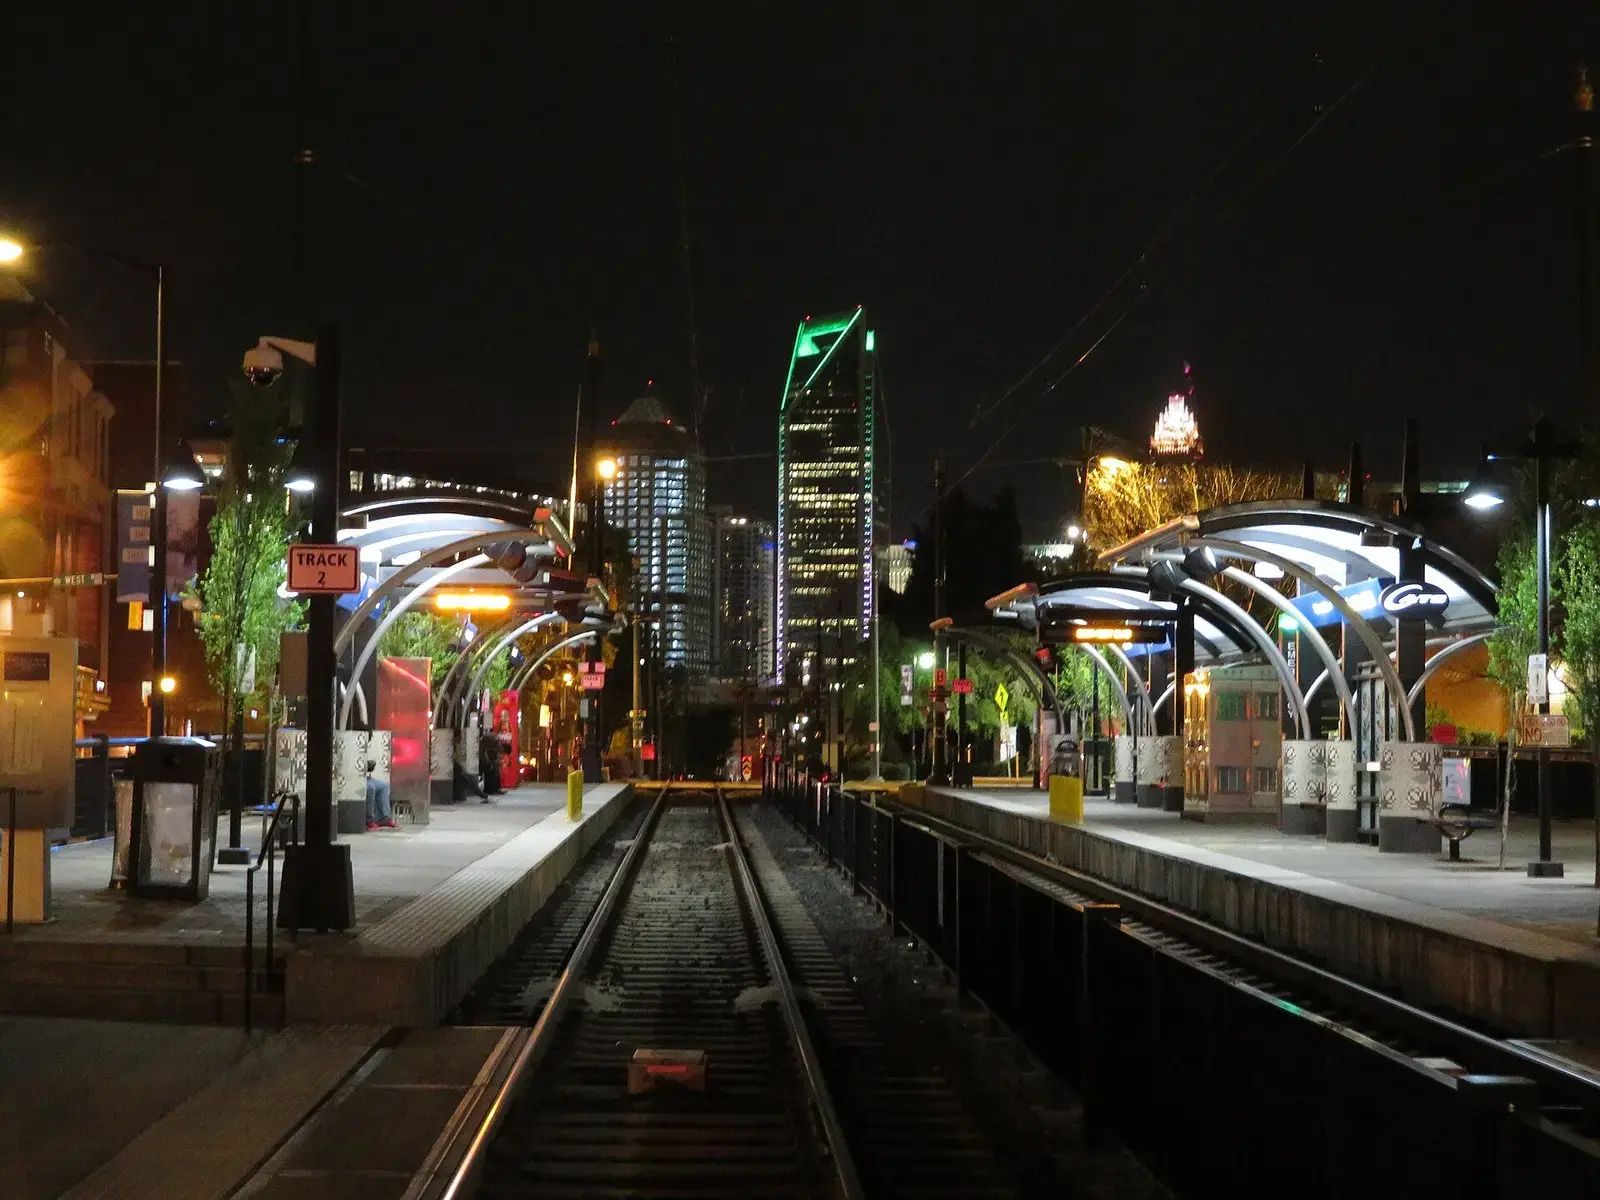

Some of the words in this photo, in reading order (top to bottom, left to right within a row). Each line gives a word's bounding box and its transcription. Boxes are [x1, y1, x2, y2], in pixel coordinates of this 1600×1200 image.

[297, 552, 347, 566] TRACK
[64, 574, 86, 585] WEST
[317, 571, 326, 584] 2
[1525, 727, 1542, 743] NO
